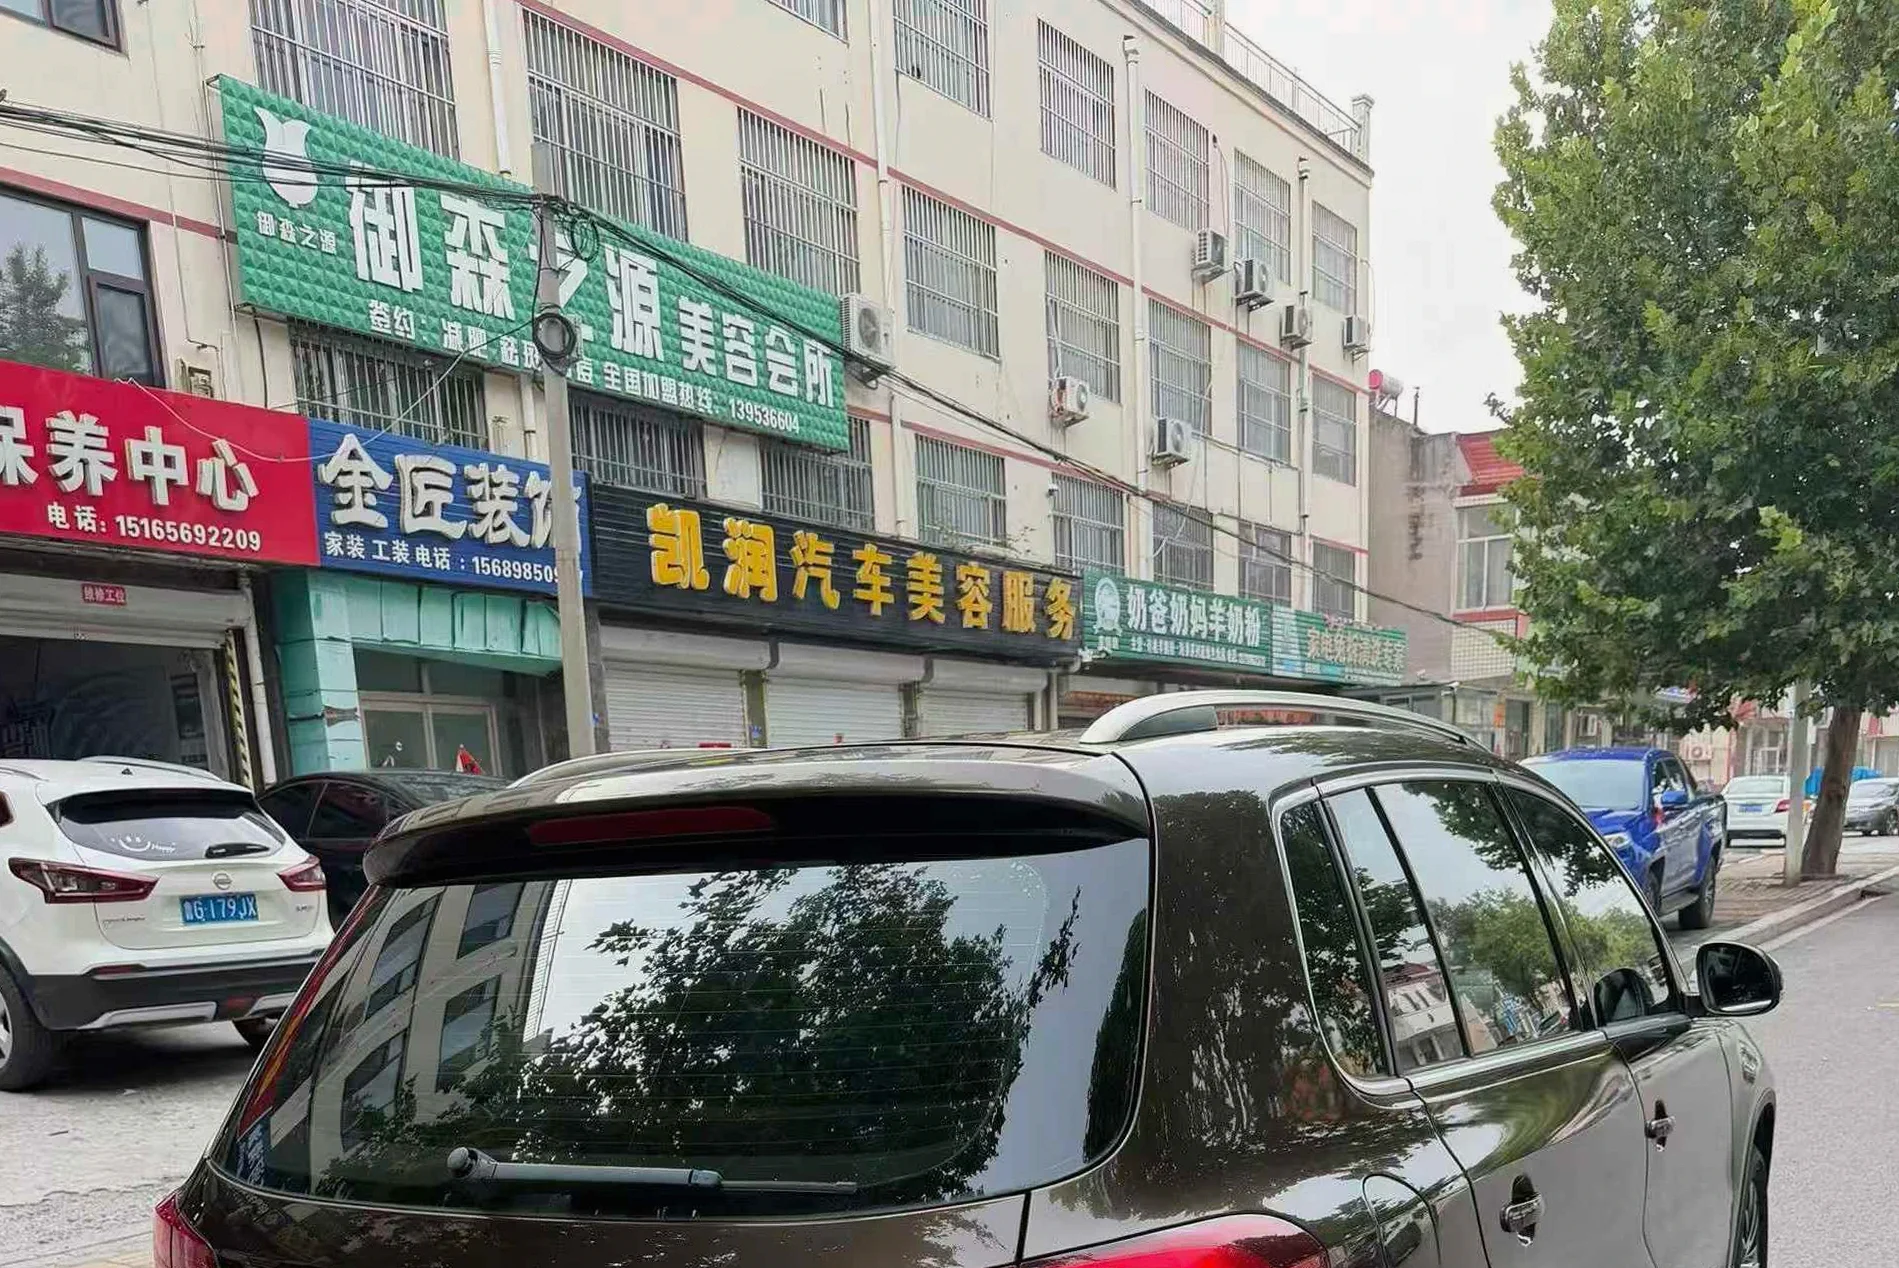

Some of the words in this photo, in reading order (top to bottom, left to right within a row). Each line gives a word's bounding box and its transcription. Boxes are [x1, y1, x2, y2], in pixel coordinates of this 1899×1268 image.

[677, 295, 834, 407] 美容会所
[728, 398, 800, 434] 139536604
[646, 503, 1077, 640] 凯润汽车美容服务
[1127, 585, 1261, 648] 奶爸奶妈羊奶粉
